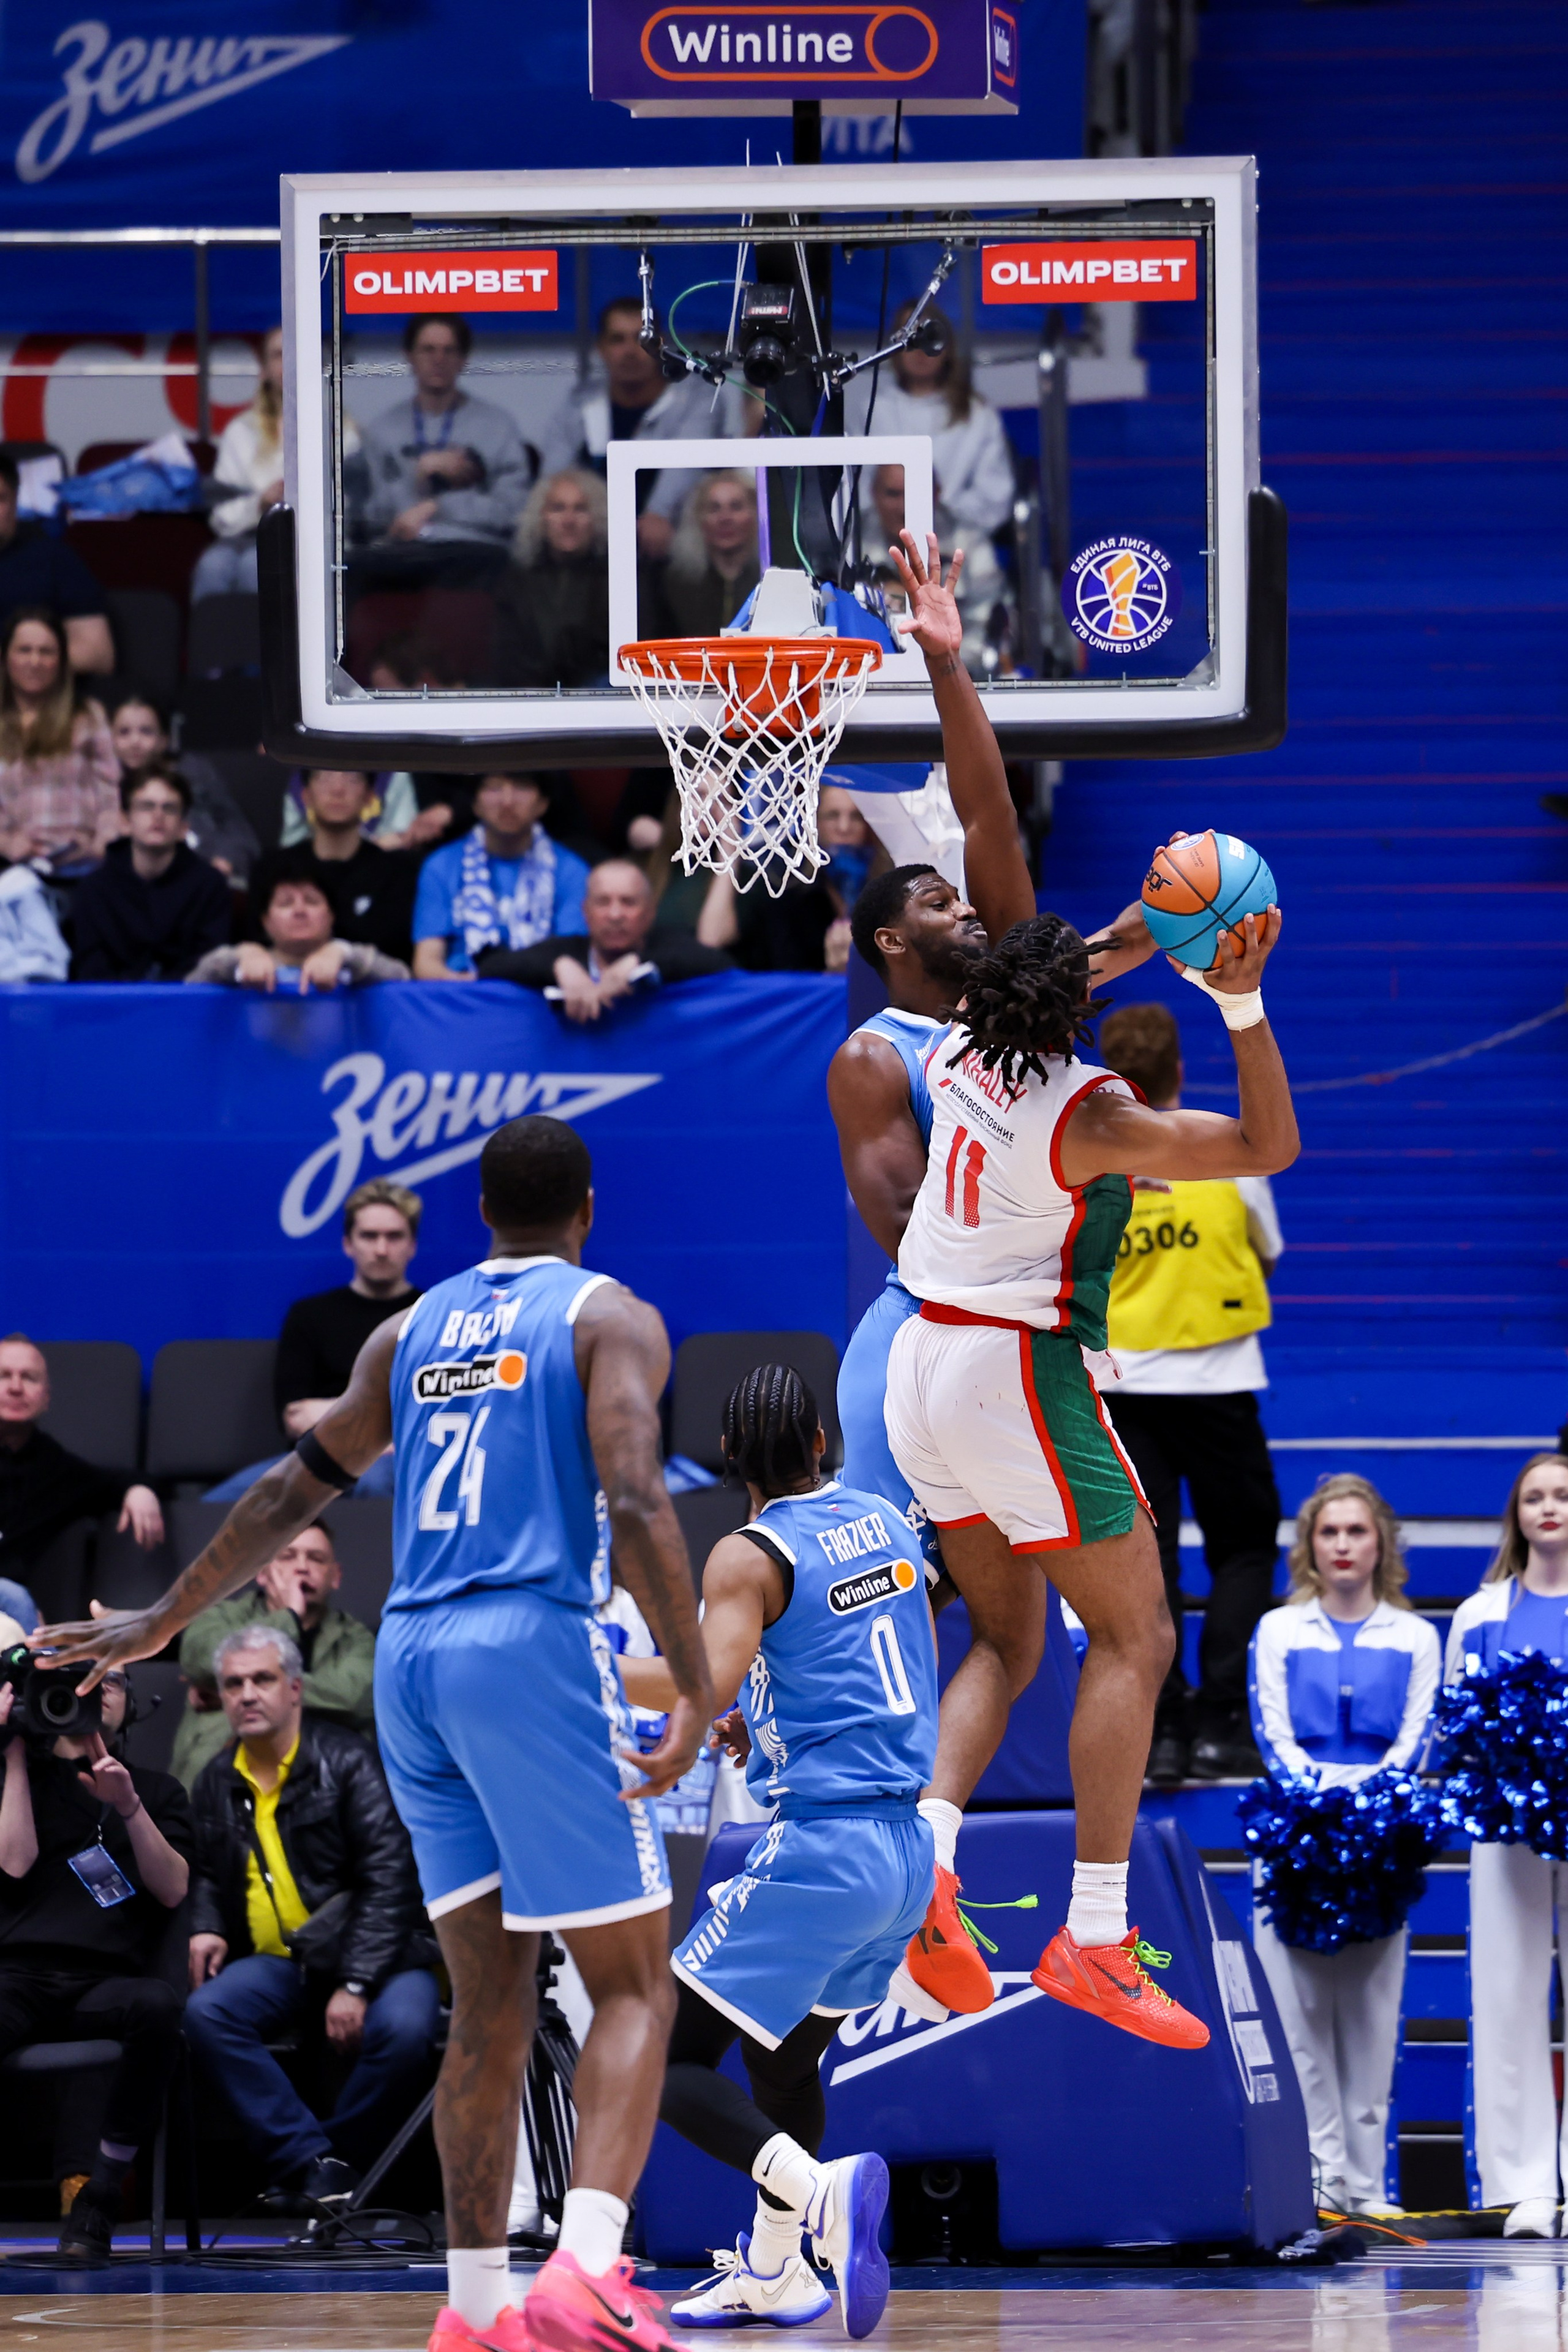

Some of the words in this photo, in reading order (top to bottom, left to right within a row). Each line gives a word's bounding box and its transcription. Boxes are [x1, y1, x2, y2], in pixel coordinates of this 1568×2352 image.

[668, 24, 854, 63] Winline
[15, 20, 354, 184] Зенит
[353, 268, 549, 295] OLIMPBET
[990, 258, 1188, 285] OLIMPBET
[1070, 537, 1116, 575] ЕДИНАЯ
[1118, 537, 1151, 554] ЛИГА
[1151, 549, 1172, 572] ВТБ
[1070, 616, 1090, 639] VTB
[1088, 634, 1132, 654] UNITED
[1133, 615, 1174, 652] LEAGUE
[949, 1083, 1016, 1142] БЛАГОСОСТОЯНИЕ
[280, 1052, 663, 1238] Зенит
[944, 1125, 987, 1229] 11
[418, 1405, 491, 1531] 24
[815, 1511, 892, 1566] FRAZIER
[833, 1575, 891, 1607] Winline
[869, 1614, 917, 1716] 0
